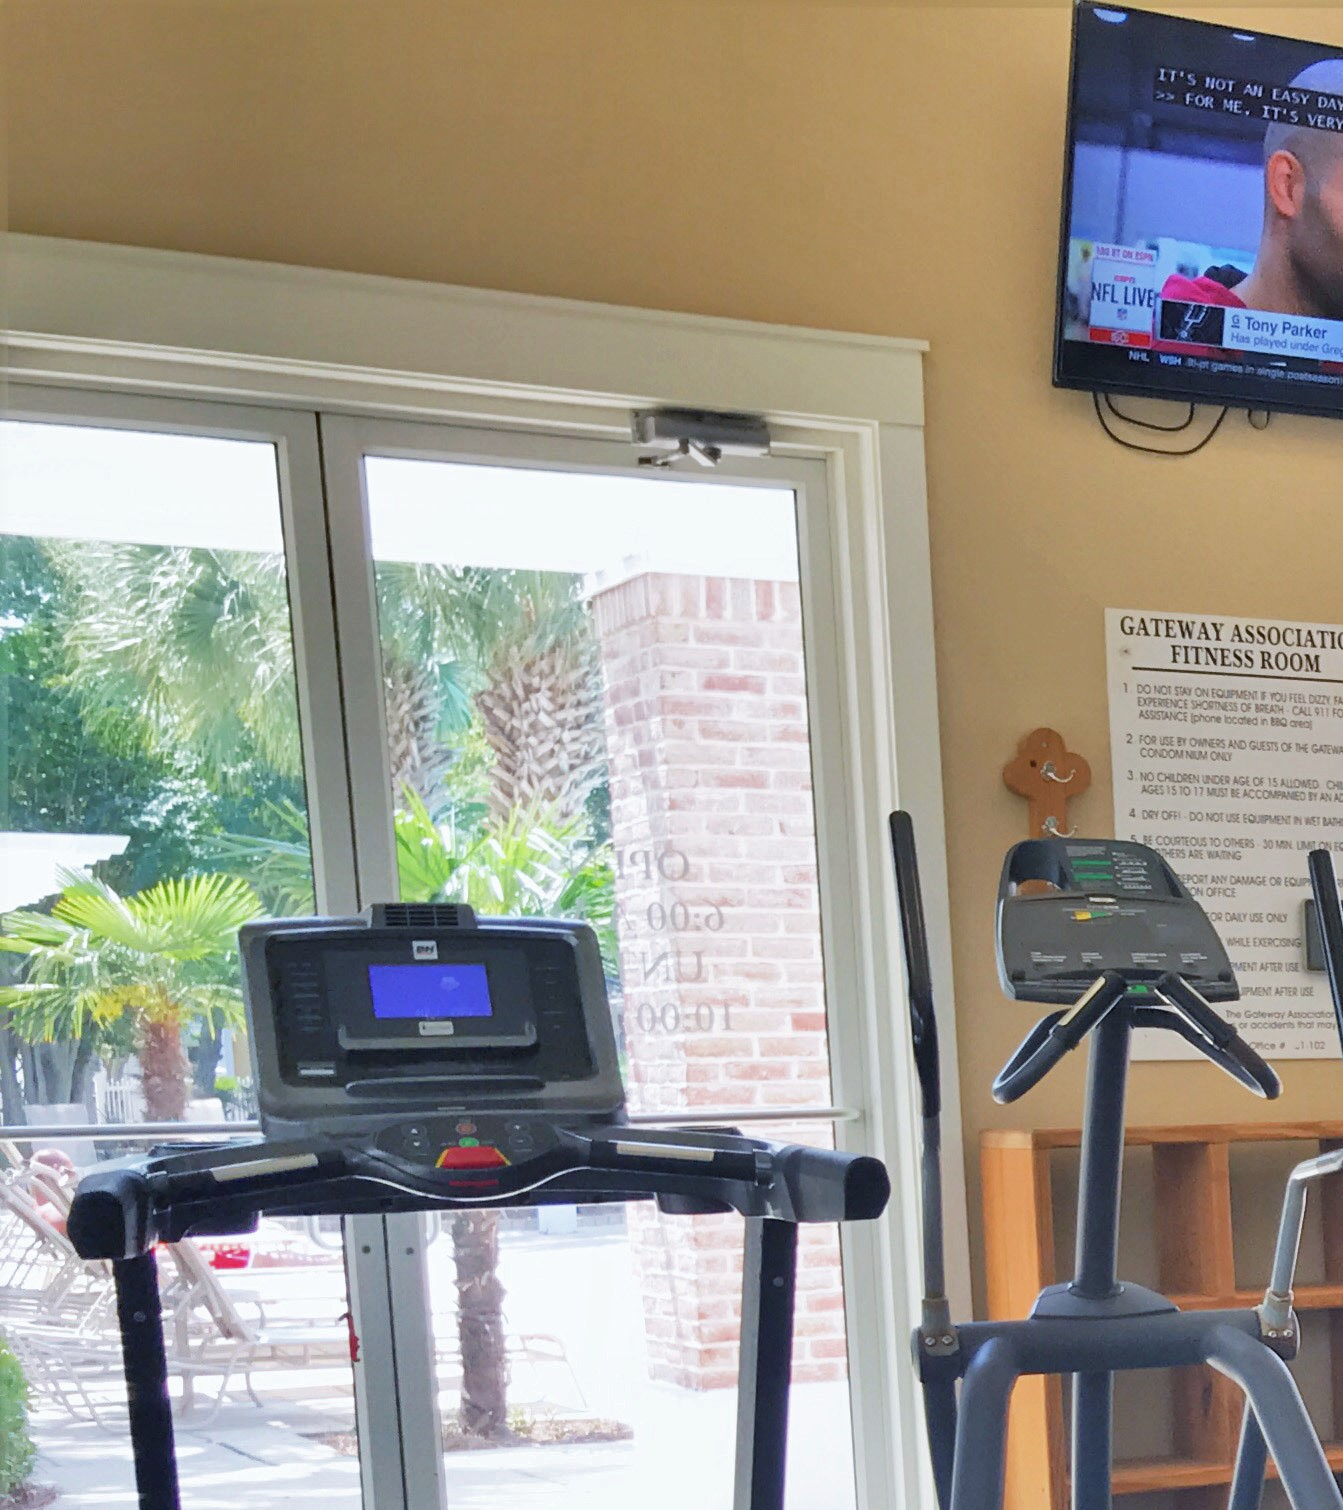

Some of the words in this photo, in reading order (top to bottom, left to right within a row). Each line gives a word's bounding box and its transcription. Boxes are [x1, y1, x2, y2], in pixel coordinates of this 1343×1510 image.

[1159, 67, 1197, 86] IT'S
[1205, 76, 1236, 93] NOT
[1243, 83, 1264, 98] AN
[1272, 88, 1310, 105] EASY
[1185, 92, 1214, 109] FOR
[1262, 105, 1299, 123] IT'S
[1090, 282, 1118, 304] NFL
[1123, 285, 1155, 308] LIVE
[1244, 316, 1278, 336] Tony
[1282, 321, 1328, 339] Parker
[1230, 332, 1250, 343] Has
[1253, 335, 1287, 350] played
[1290, 340, 1319, 352] under
[1128, 350, 1150, 362] NHL
[1211, 362, 1243, 375] games
[1120, 615, 1225, 641] GATEWAY
[1170, 644, 1255, 669] FITNESS
[1259, 650, 1322, 673] ROOM
[1136, 684, 1152, 695] DO
[1153, 685, 1172, 696] NOT
[1174, 686, 1192, 697] STAY
[1194, 687, 1209, 698] ON
[1211, 688, 1258, 701] EQUIPMENT
[1261, 691, 1267, 700] IF
[1270, 692, 1287, 703] YOU
[1288, 693, 1307, 704] FEEL
[1137, 697, 1188, 710] EXPERIENCE
[1190, 700, 1238, 712] SHORTNESS
[1240, 702, 1252, 713] OF
[1254, 703, 1284, 715] BREATH
[1292, 706, 1312, 717] CALL
[1315, 707, 1329, 717] 911
[1138, 710, 1188, 722] ASSISTANCE
[1224, 714, 1258, 726] located
[1260, 717, 1268, 726] in
[1270, 717, 1287, 728] BBQ
[1139, 734, 1157, 746] FOR
[1159, 735, 1174, 747] USE
[1176, 736, 1187, 747] BY
[1189, 737, 1226, 749] OWNERS
[1228, 739, 1247, 750] AND
[1248, 740, 1279, 752] GUESTS
[1280, 742, 1292, 753] OF
[1295, 742, 1309, 754] THE
[1210, 750, 1232, 762] ONLY
[1140, 771, 1155, 782] NO
[1156, 772, 1200, 784] CHILDREN
[1202, 774, 1230, 785] UNDER
[1232, 776, 1250, 787] AGE
[1252, 776, 1264, 787] OF
[1268, 777, 1279, 788] 15
[1141, 784, 1165, 796] AGES
[1167, 785, 1177, 796] 15
[1179, 786, 1191, 797] TO
[1194, 786, 1204, 797] 17
[1206, 787, 1229, 798] MUST
[1230, 788, 1241, 799] BE
[1242, 789, 1307, 801] ACCOMPANIED
[1308, 791, 1318, 802] BY
[1319, 792, 1332, 802] AN
[1141, 809, 1159, 820] DRY
[1189, 811, 1203, 822] DO
[1205, 812, 1224, 823] NOT
[1225, 813, 1240, 823] USE
[1242, 813, 1291, 825] EQUIPMENT
[1293, 815, 1303, 826] IN
[1304, 816, 1321, 827] WET
[1155, 835, 1208, 847] COURTEOUS
[1209, 837, 1222, 848] TO
[1223, 837, 1255, 849] OTHERS
[1262, 839, 1274, 850] 30
[1296, 840, 1316, 851] LIMIT
[1318, 841, 1332, 851] ON
[1188, 849, 1204, 860] ARE
[1206, 850, 1242, 861] WAITING
[1210, 874, 1228, 885] ANY
[1229, 875, 1267, 887] DAMAGE
[1270, 876, 1283, 887] OR
[1205, 887, 1236, 898] OFFICE
[1225, 912, 1248, 923] DAILY
[1249, 913, 1264, 923] USE
[1266, 913, 1288, 923] ONLY
[1226, 937, 1251, 948] WHILE
[1252, 937, 1301, 949] EXERCISING
[1260, 962, 1284, 973] AFTER
[1285, 962, 1300, 973] USE
[1274, 987, 1298, 997] AFTER
[1300, 987, 1315, 997] USE
[1226, 1009, 1242, 1019] The
[1244, 1009, 1285, 1020] Gateway
[1287, 1010, 1335, 1019] Association
[1249, 1020, 1295, 1030] accidents
[1297, 1021, 1315, 1030] that
